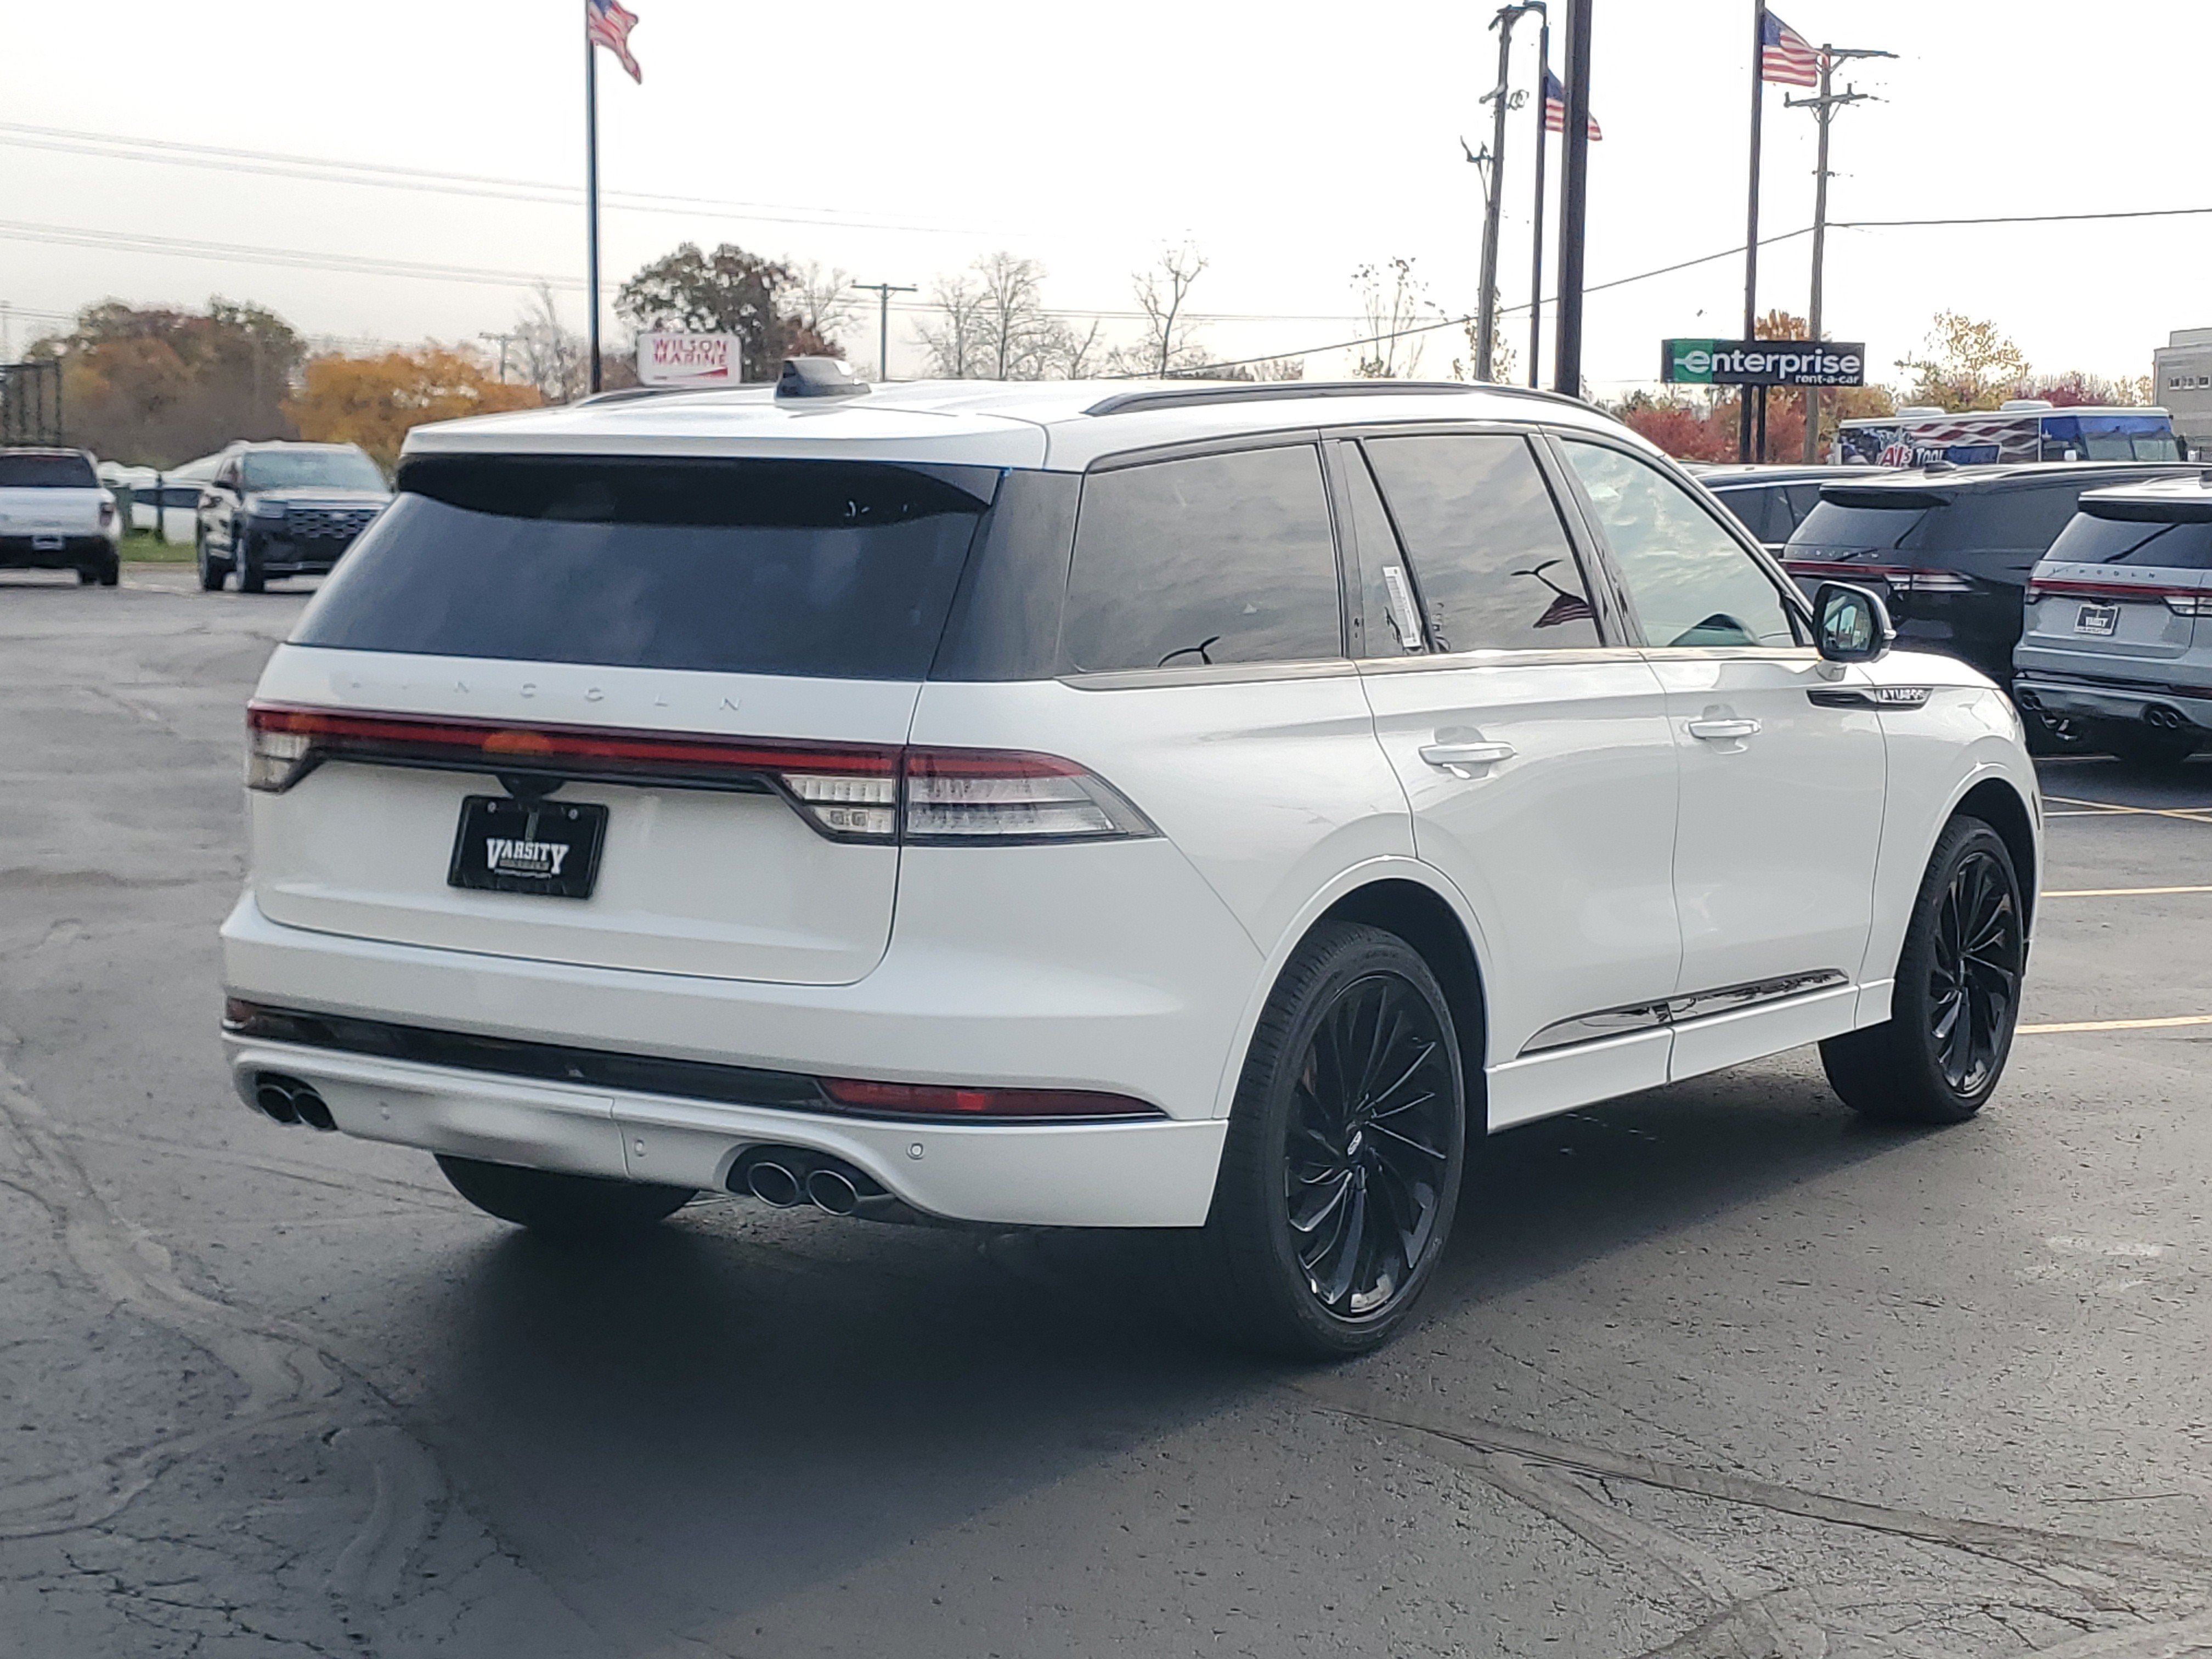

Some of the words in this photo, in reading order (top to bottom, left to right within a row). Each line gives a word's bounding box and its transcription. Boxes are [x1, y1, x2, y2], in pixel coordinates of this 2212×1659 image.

[653, 338, 727, 352] WILSON
[653, 352, 726, 364] MARINE
[1675, 348, 1861, 379] enterprise
[351, 680, 741, 711] NCOLN
[486, 838, 569, 874] VARSITY
